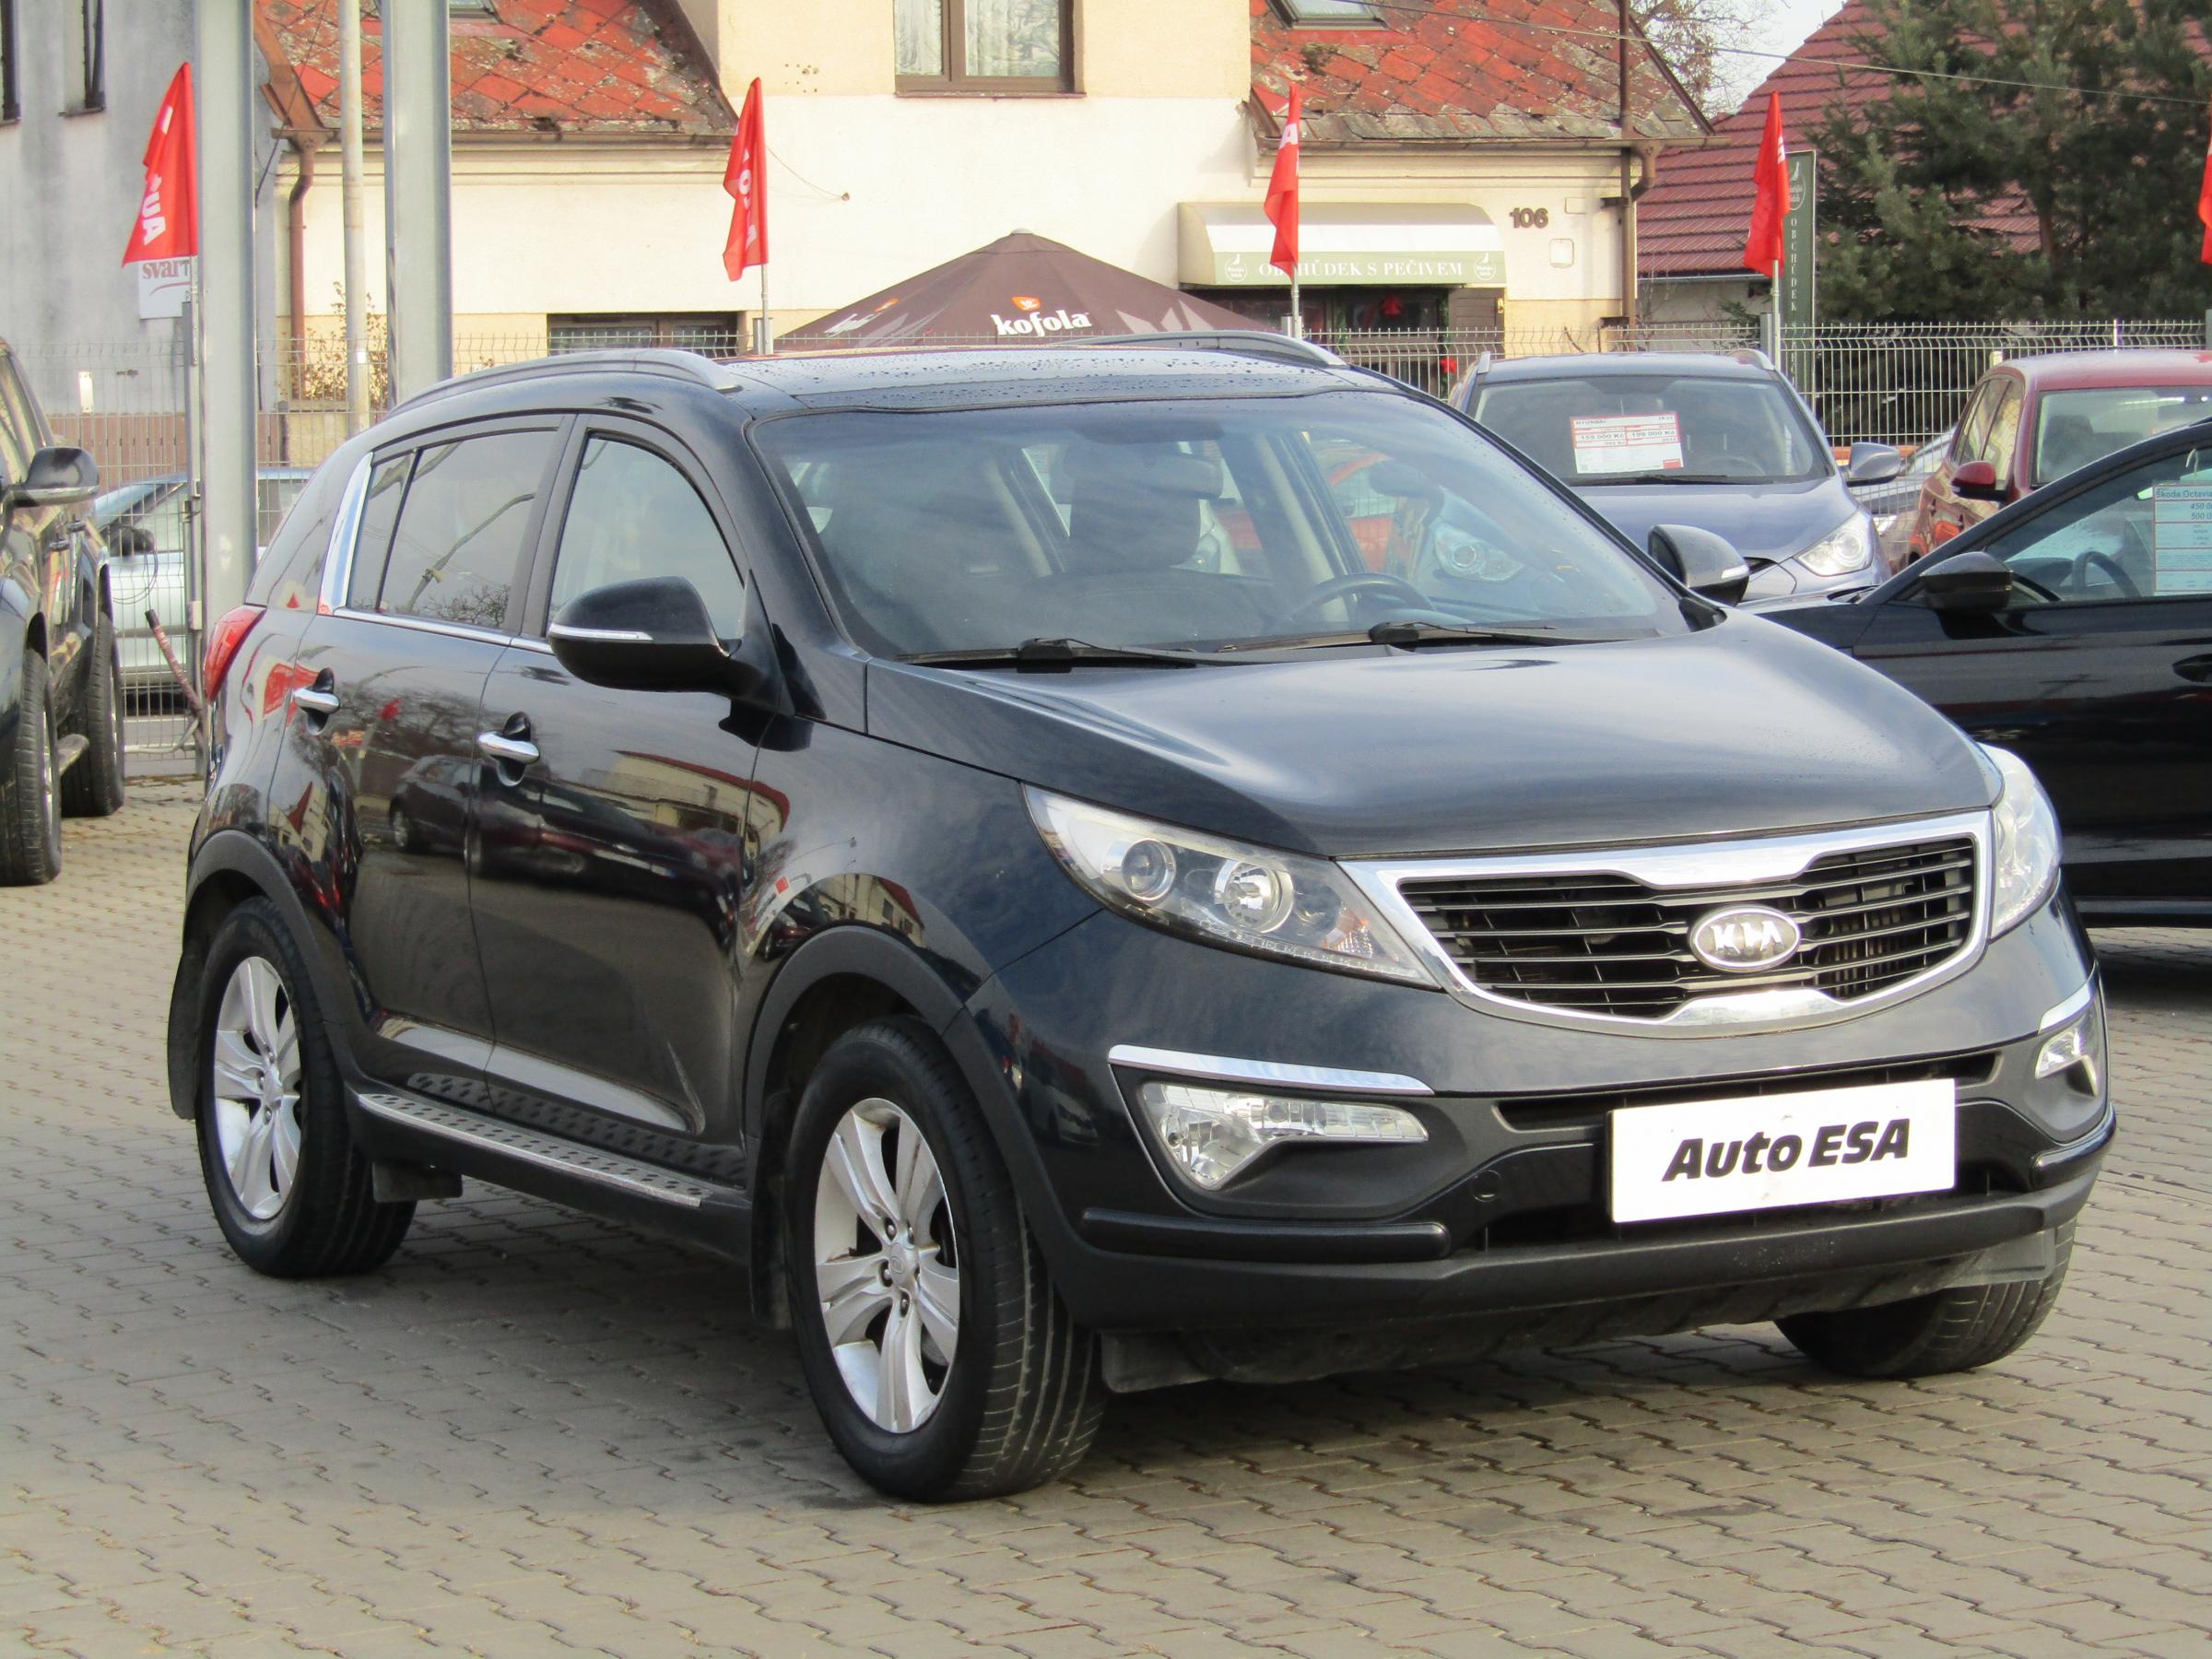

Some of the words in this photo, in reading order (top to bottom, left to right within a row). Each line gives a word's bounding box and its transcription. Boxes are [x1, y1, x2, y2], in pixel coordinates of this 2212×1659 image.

[1509, 207, 1548, 229] 106
[1367, 262, 1378, 276] S
[1383, 259, 1464, 276] PEČIVEM
[990, 310, 1092, 337] kofola
[1710, 920, 1785, 954] KIA
[1661, 1131, 1803, 1182] Auto
[1806, 1118, 1911, 1168] ESA
